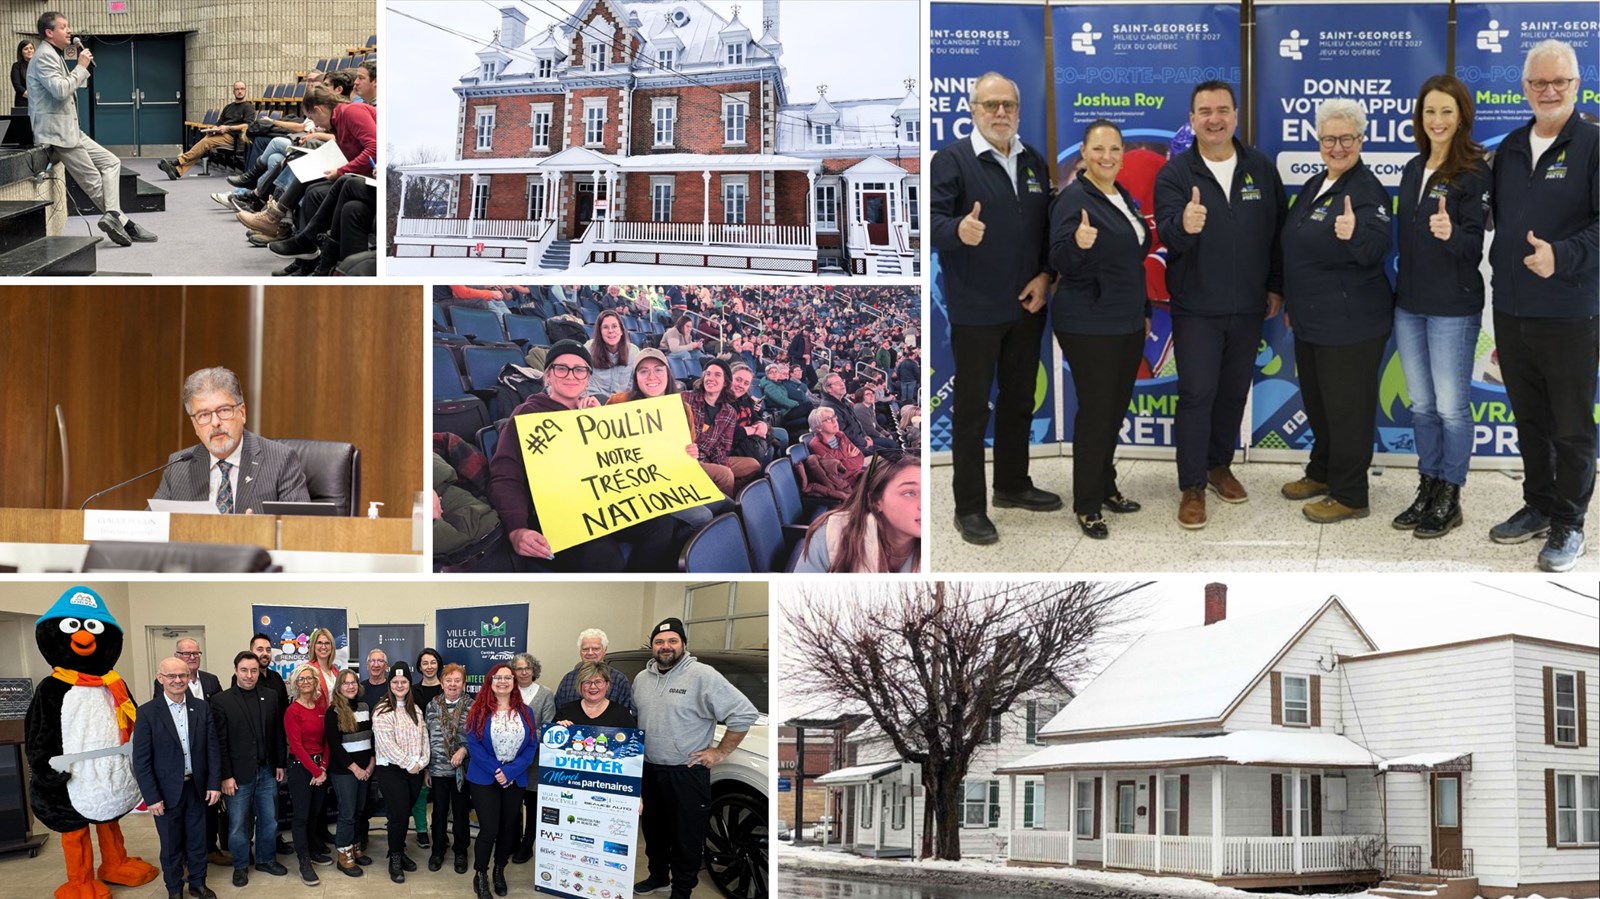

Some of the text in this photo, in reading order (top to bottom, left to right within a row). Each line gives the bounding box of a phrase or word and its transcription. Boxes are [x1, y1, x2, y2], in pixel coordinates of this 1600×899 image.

[1113, 24, 1209, 33] SAINT-GEORGES
[1521, 21, 1599, 30] SAINT-GEOR
[1320, 31, 1412, 40] SAINT-GEORGES
[1147, 42, 1178, 50] QUÉBEC
[1304, 79, 1392, 95] DONNEZ
[1073, 92, 1164, 109] Joshua Roy
[1283, 119, 1320, 142] EN
[525, 418, 563, 455] #29
[596, 447, 644, 468] NOTRE
[581, 464, 671, 501] TRÉSOR
[447, 629, 467, 637] VILLE
[446, 637, 516, 649] BEAUCEVILLE
[555, 756, 623, 774] D'HIVER
[543, 770, 579, 784] Merci
[581, 779, 634, 793] partenaires
